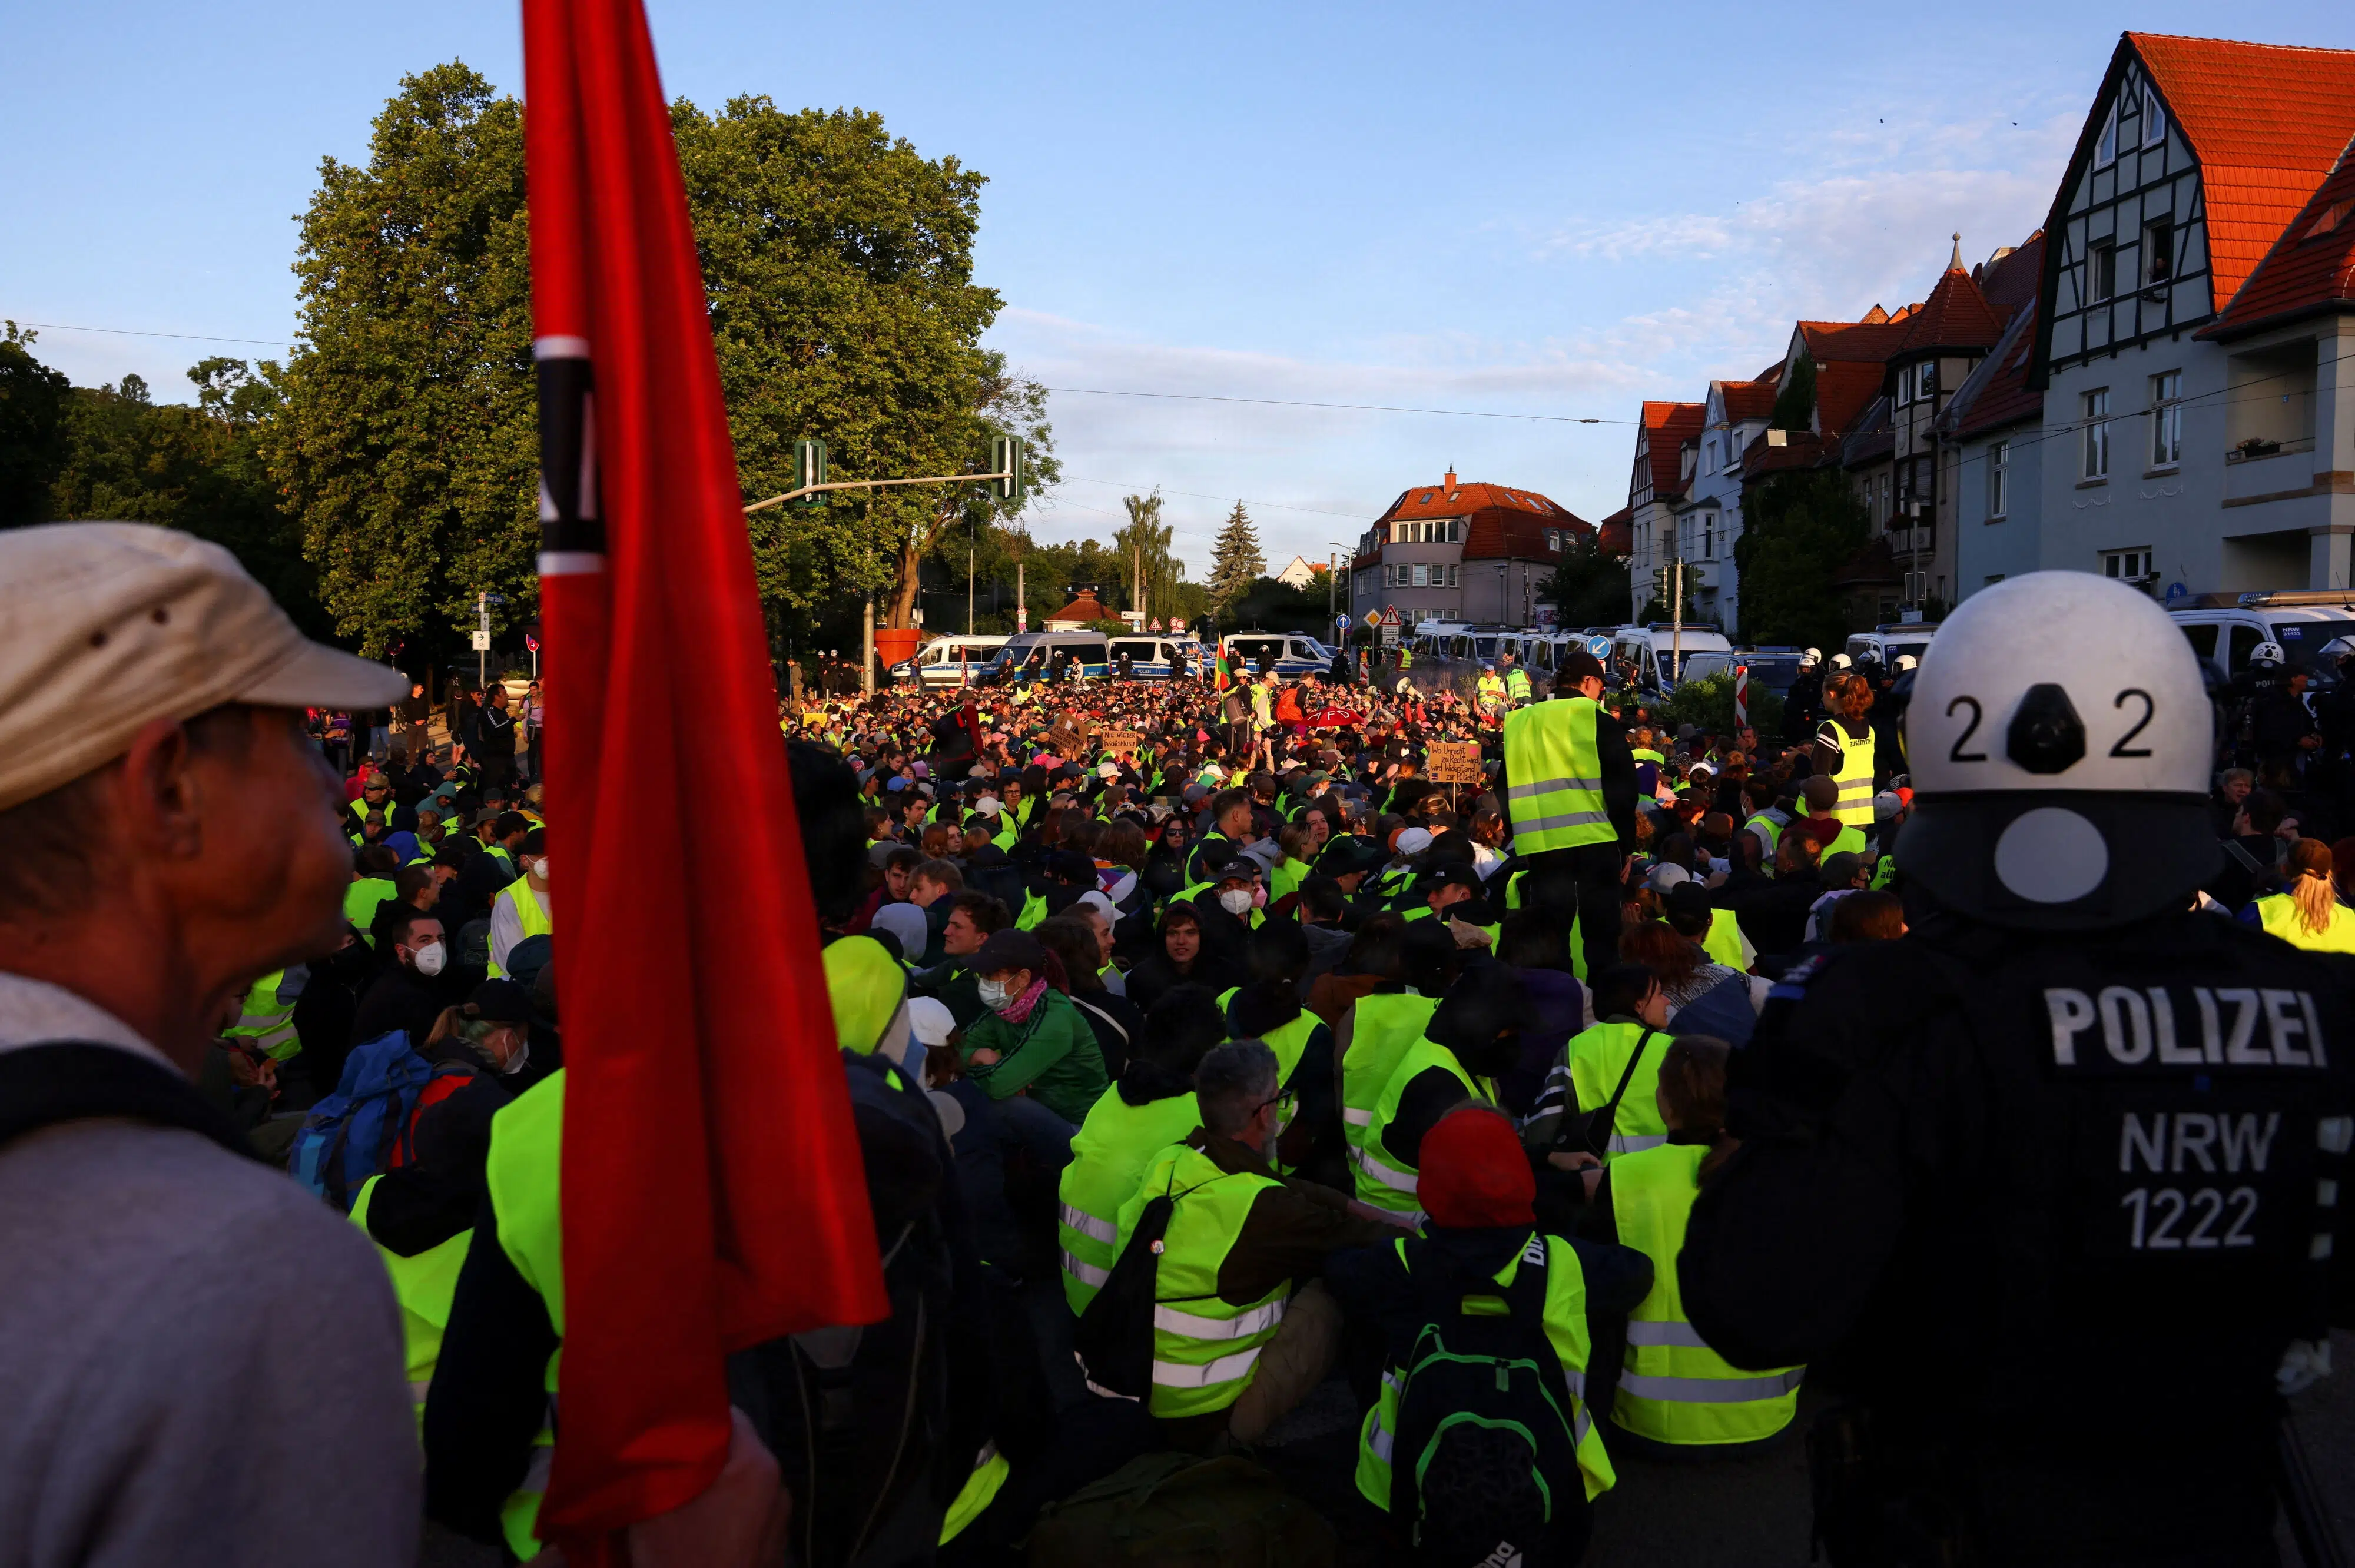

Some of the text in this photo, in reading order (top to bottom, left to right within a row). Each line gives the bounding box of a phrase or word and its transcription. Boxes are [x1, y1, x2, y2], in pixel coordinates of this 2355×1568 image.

[1306, 710, 1350, 721] AFD
[1946, 688, 2154, 762] 2 2
[1054, 726, 1066, 736] ALLE
[1432, 744, 1466, 755] Wo Unrecht
[1450, 754, 1466, 763] Recht
[1467, 755, 1480, 765] wird,
[1431, 763, 1475, 772] wird Widerstand
[1457, 772, 1480, 782] Pflicht!
[2042, 985, 2329, 1069] POLIZEI
[2118, 1111, 2281, 1174] NRW
[2120, 1185, 2259, 1250] 1222
